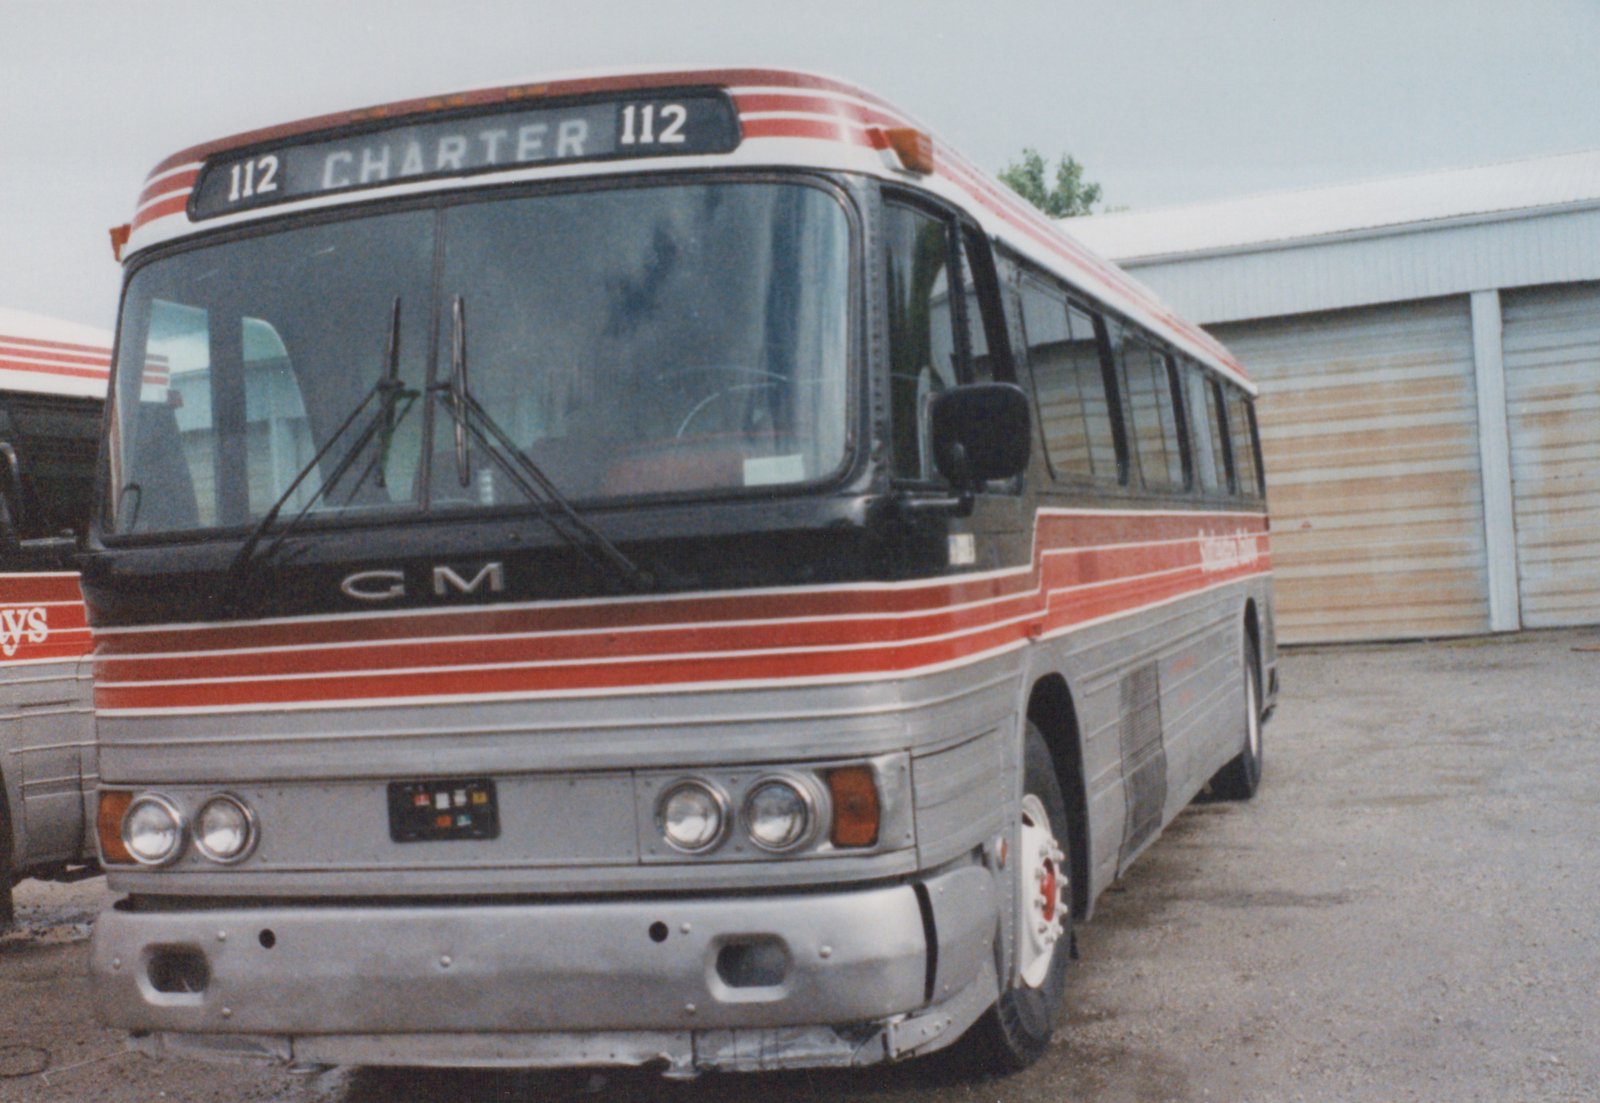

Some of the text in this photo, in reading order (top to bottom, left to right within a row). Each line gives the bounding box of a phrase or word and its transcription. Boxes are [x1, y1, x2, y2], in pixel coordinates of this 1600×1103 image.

[620, 104, 687, 144] 112
[322, 119, 588, 190] CHARTER
[228, 156, 278, 201] 112
[0, 607, 48, 656] ys
